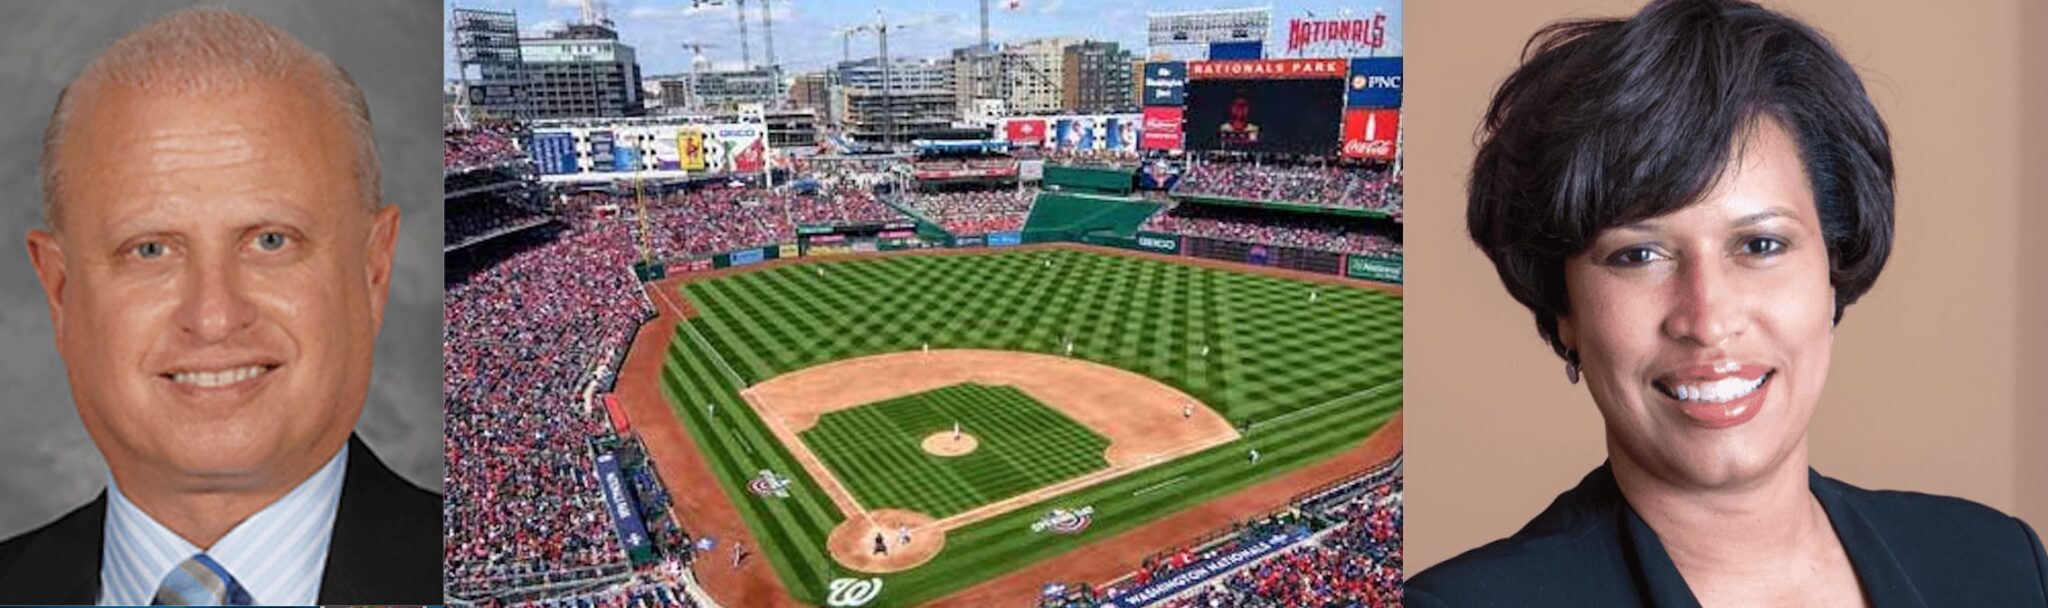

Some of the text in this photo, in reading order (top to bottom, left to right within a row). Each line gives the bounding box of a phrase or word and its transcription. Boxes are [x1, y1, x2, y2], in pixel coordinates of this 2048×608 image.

[1287, 13, 1386, 51] NATIONALS
[1193, 61, 1337, 75] NATIONALS PARK
[1368, 75, 1401, 89] PNC
[1138, 236, 1176, 250] GEICO
[1124, 567, 1208, 604] WASHINGTON
